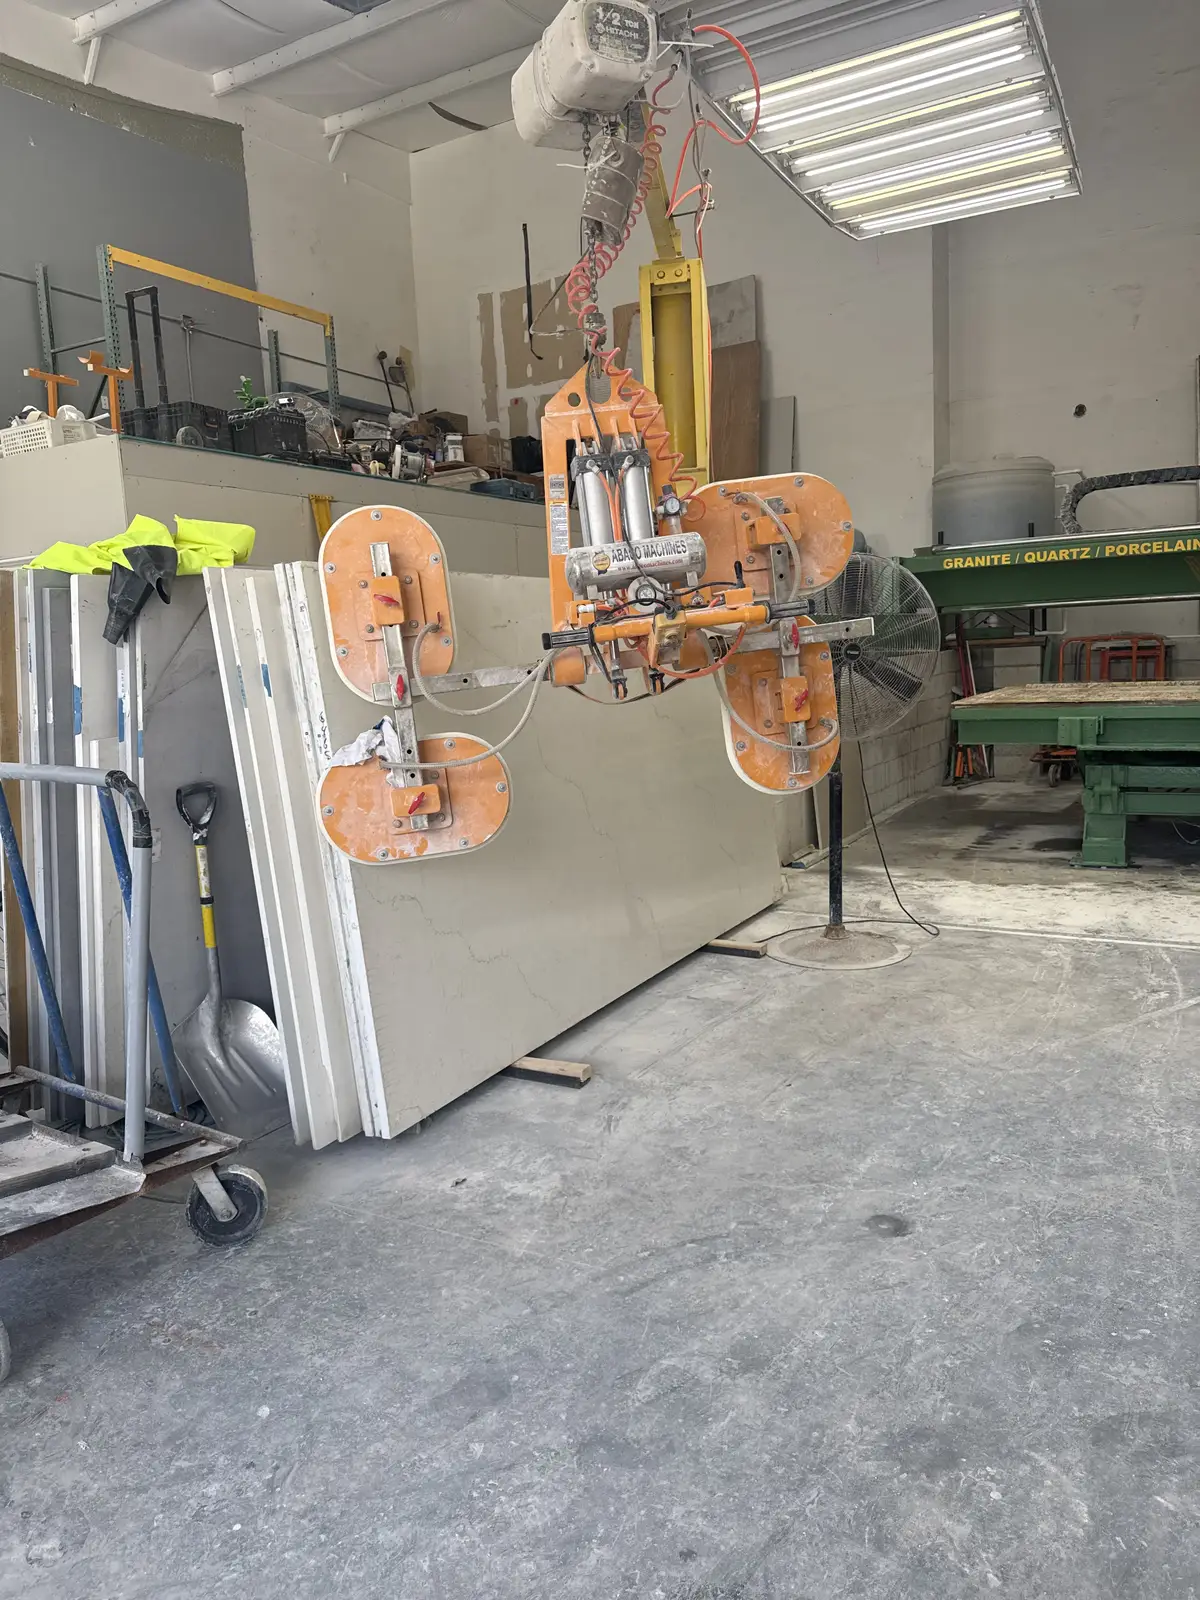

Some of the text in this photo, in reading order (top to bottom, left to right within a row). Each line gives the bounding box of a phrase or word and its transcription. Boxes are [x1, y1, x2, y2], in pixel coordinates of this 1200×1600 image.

[596, 6, 639, 29] 1/2 TON
[605, 26, 639, 39] HITACHI
[642, 540, 687, 559] MACHINES
[943, 539, 1200, 569] GRANITE / QUARTZ / PORCELAIN
